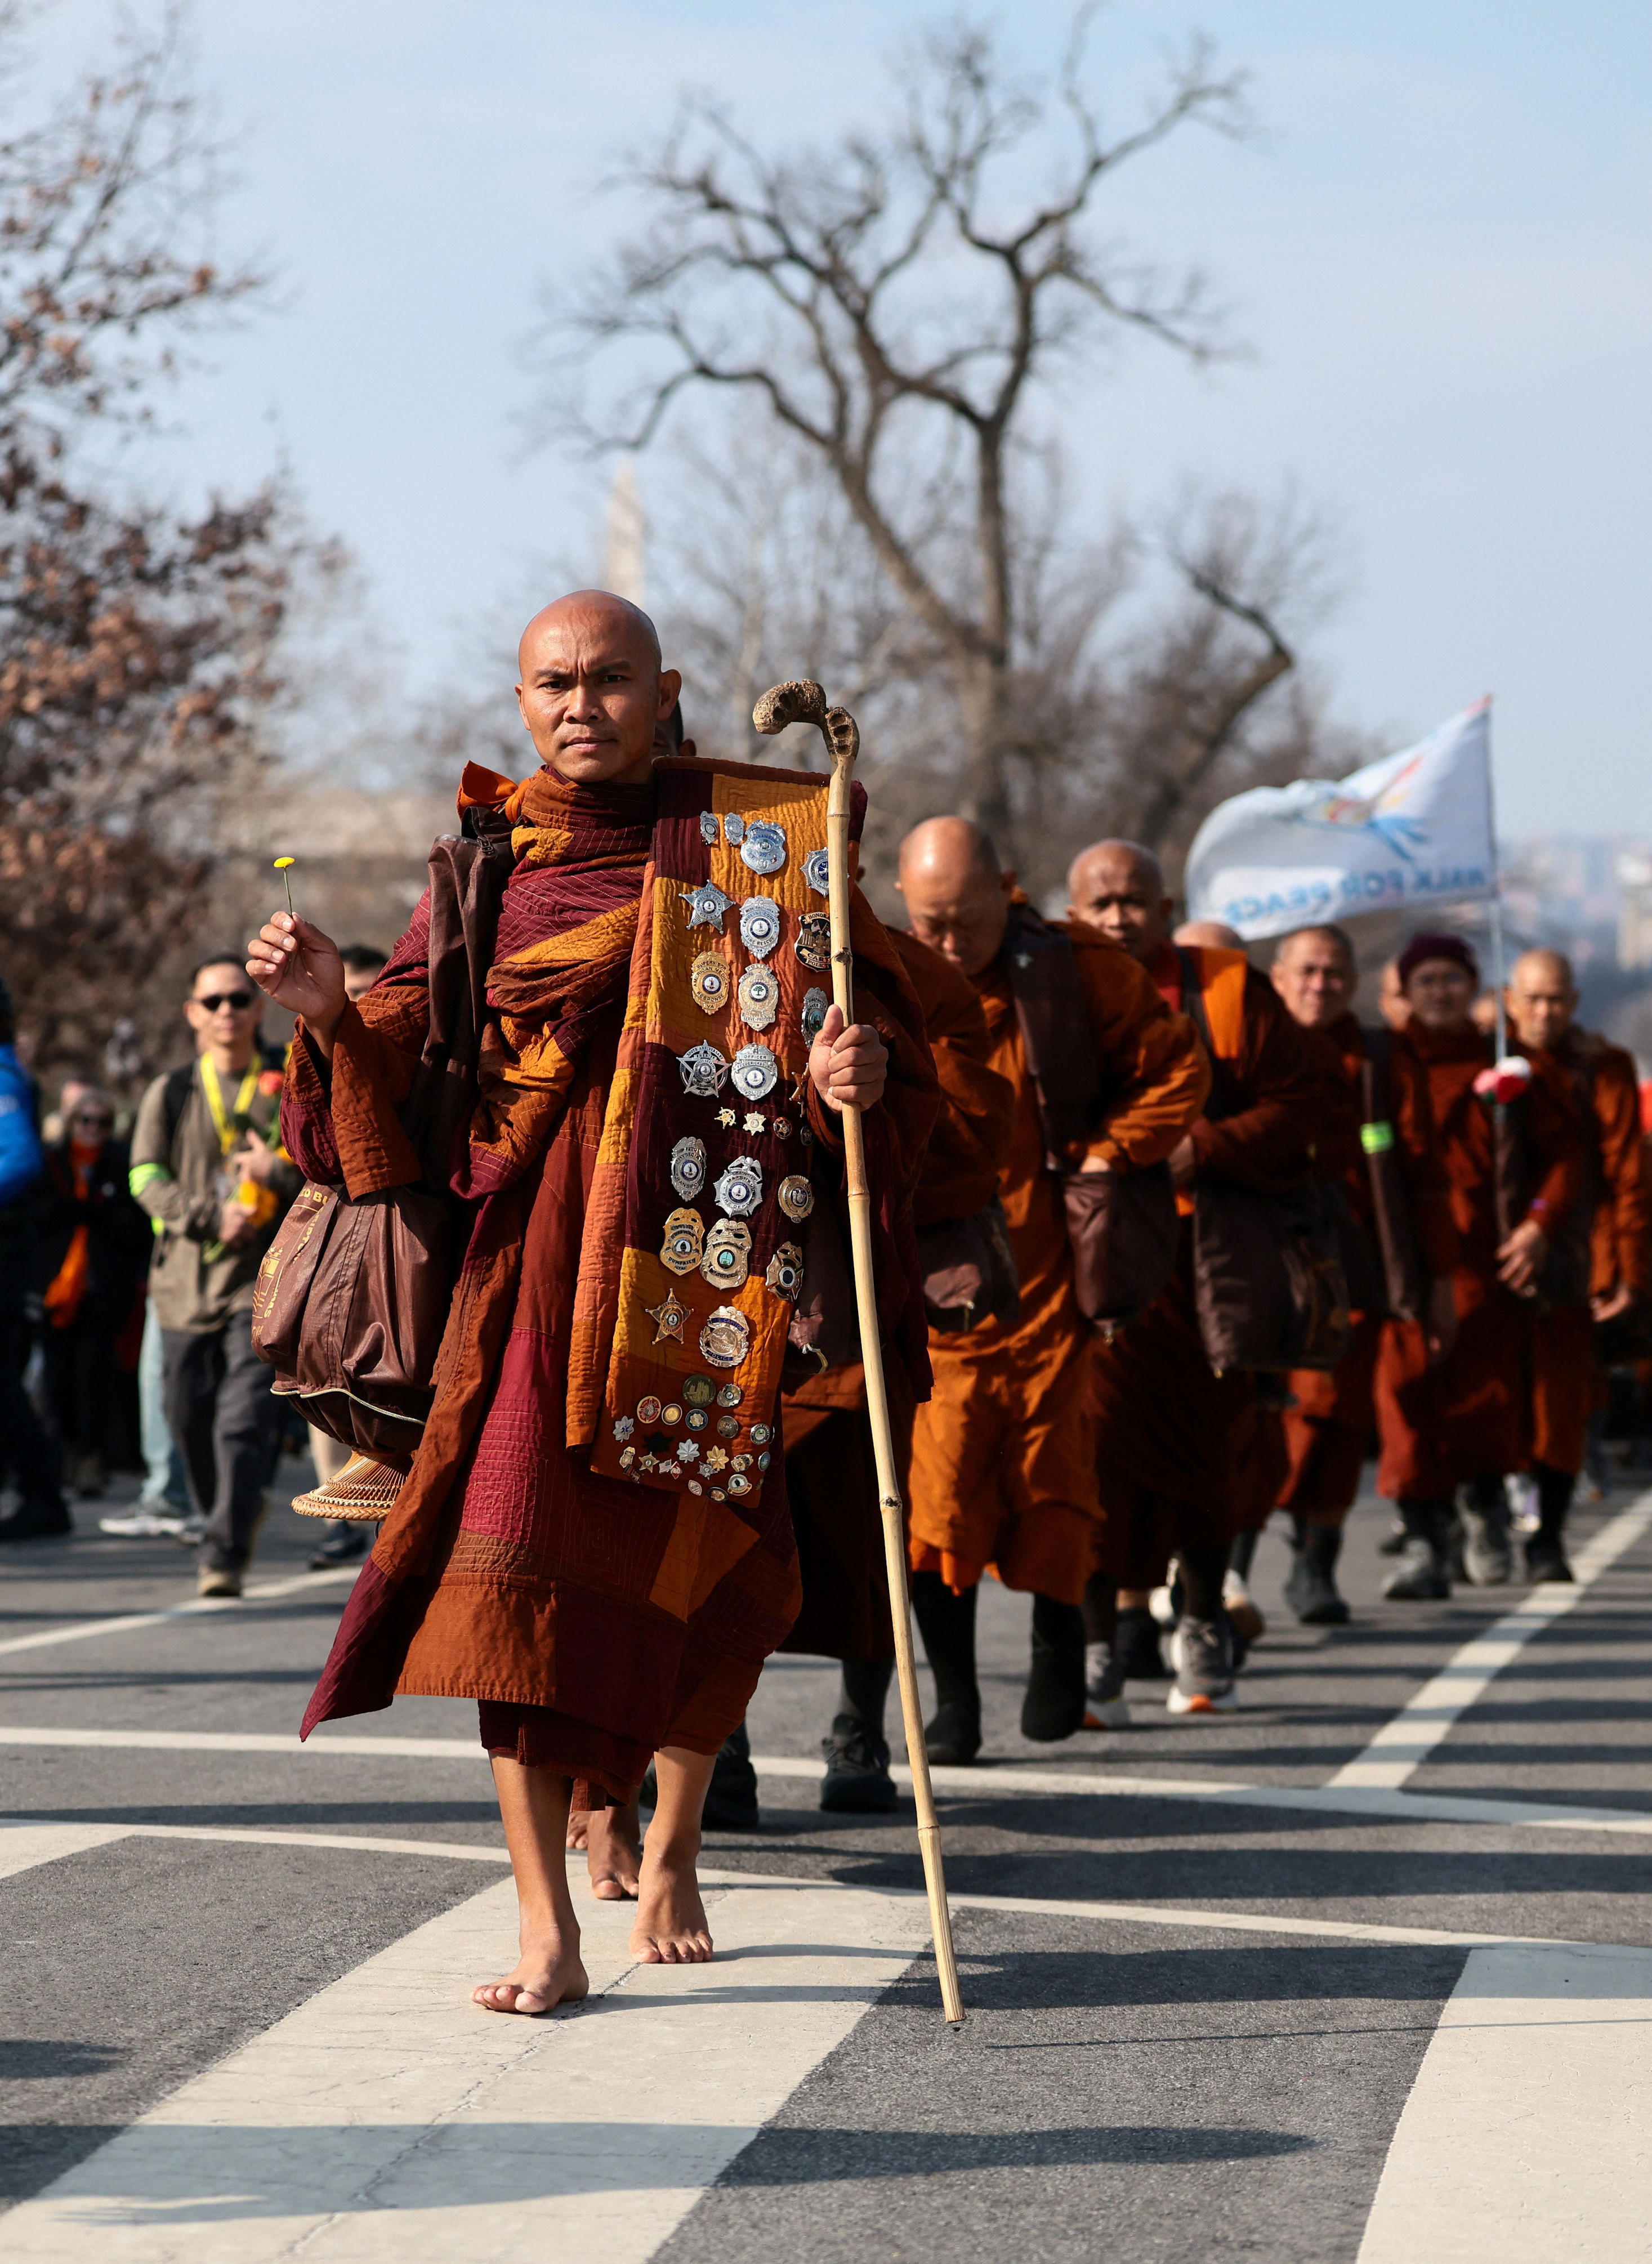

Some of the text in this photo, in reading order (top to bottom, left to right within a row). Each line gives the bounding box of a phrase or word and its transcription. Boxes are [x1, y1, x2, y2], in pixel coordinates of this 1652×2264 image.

[710, 888, 725, 899] SHERIFF
[697, 894, 721, 911] CAROLINE COUNTY
[743, 911, 778, 928] CAROLINE COUNTY
[745, 935, 775, 946] FIRE RESCUE
[697, 961, 726, 970] SUPERVISOR
[694, 967, 728, 989] AMERICAN MEDICAL
[696, 991, 725, 1002] RESPONSE
[699, 1046, 724, 1059] ANNIVERSARY
[737, 1061, 772, 1070] FREDERICKSBURG
[724, 1319, 743, 1330] CAPITOL
[708, 1351, 731, 1360] POLICE
